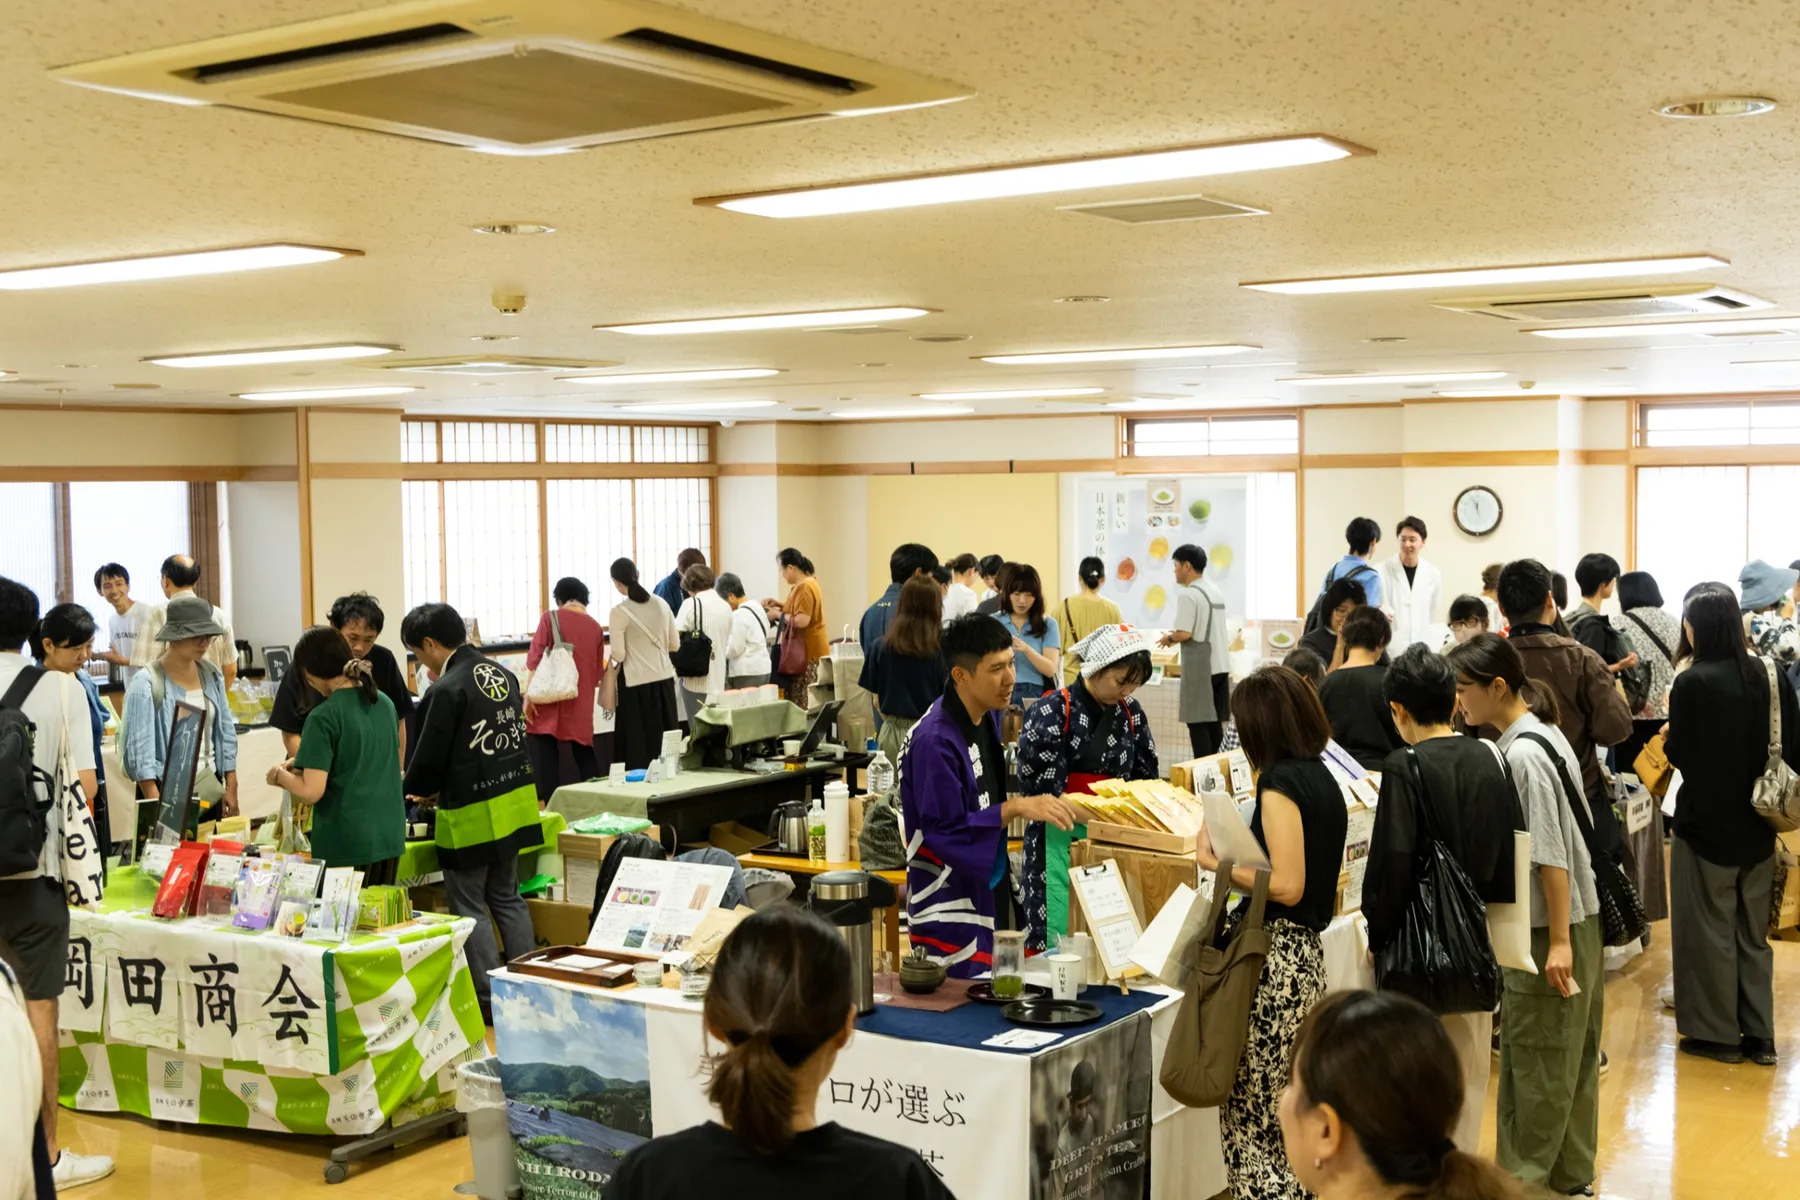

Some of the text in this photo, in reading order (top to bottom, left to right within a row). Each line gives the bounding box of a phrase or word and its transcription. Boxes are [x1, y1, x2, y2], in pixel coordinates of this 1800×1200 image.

[474, 666, 509, 699] 茶
[64, 936, 322, 1046] 岡田商会
[1106, 1140, 1137, 1157] TEA
